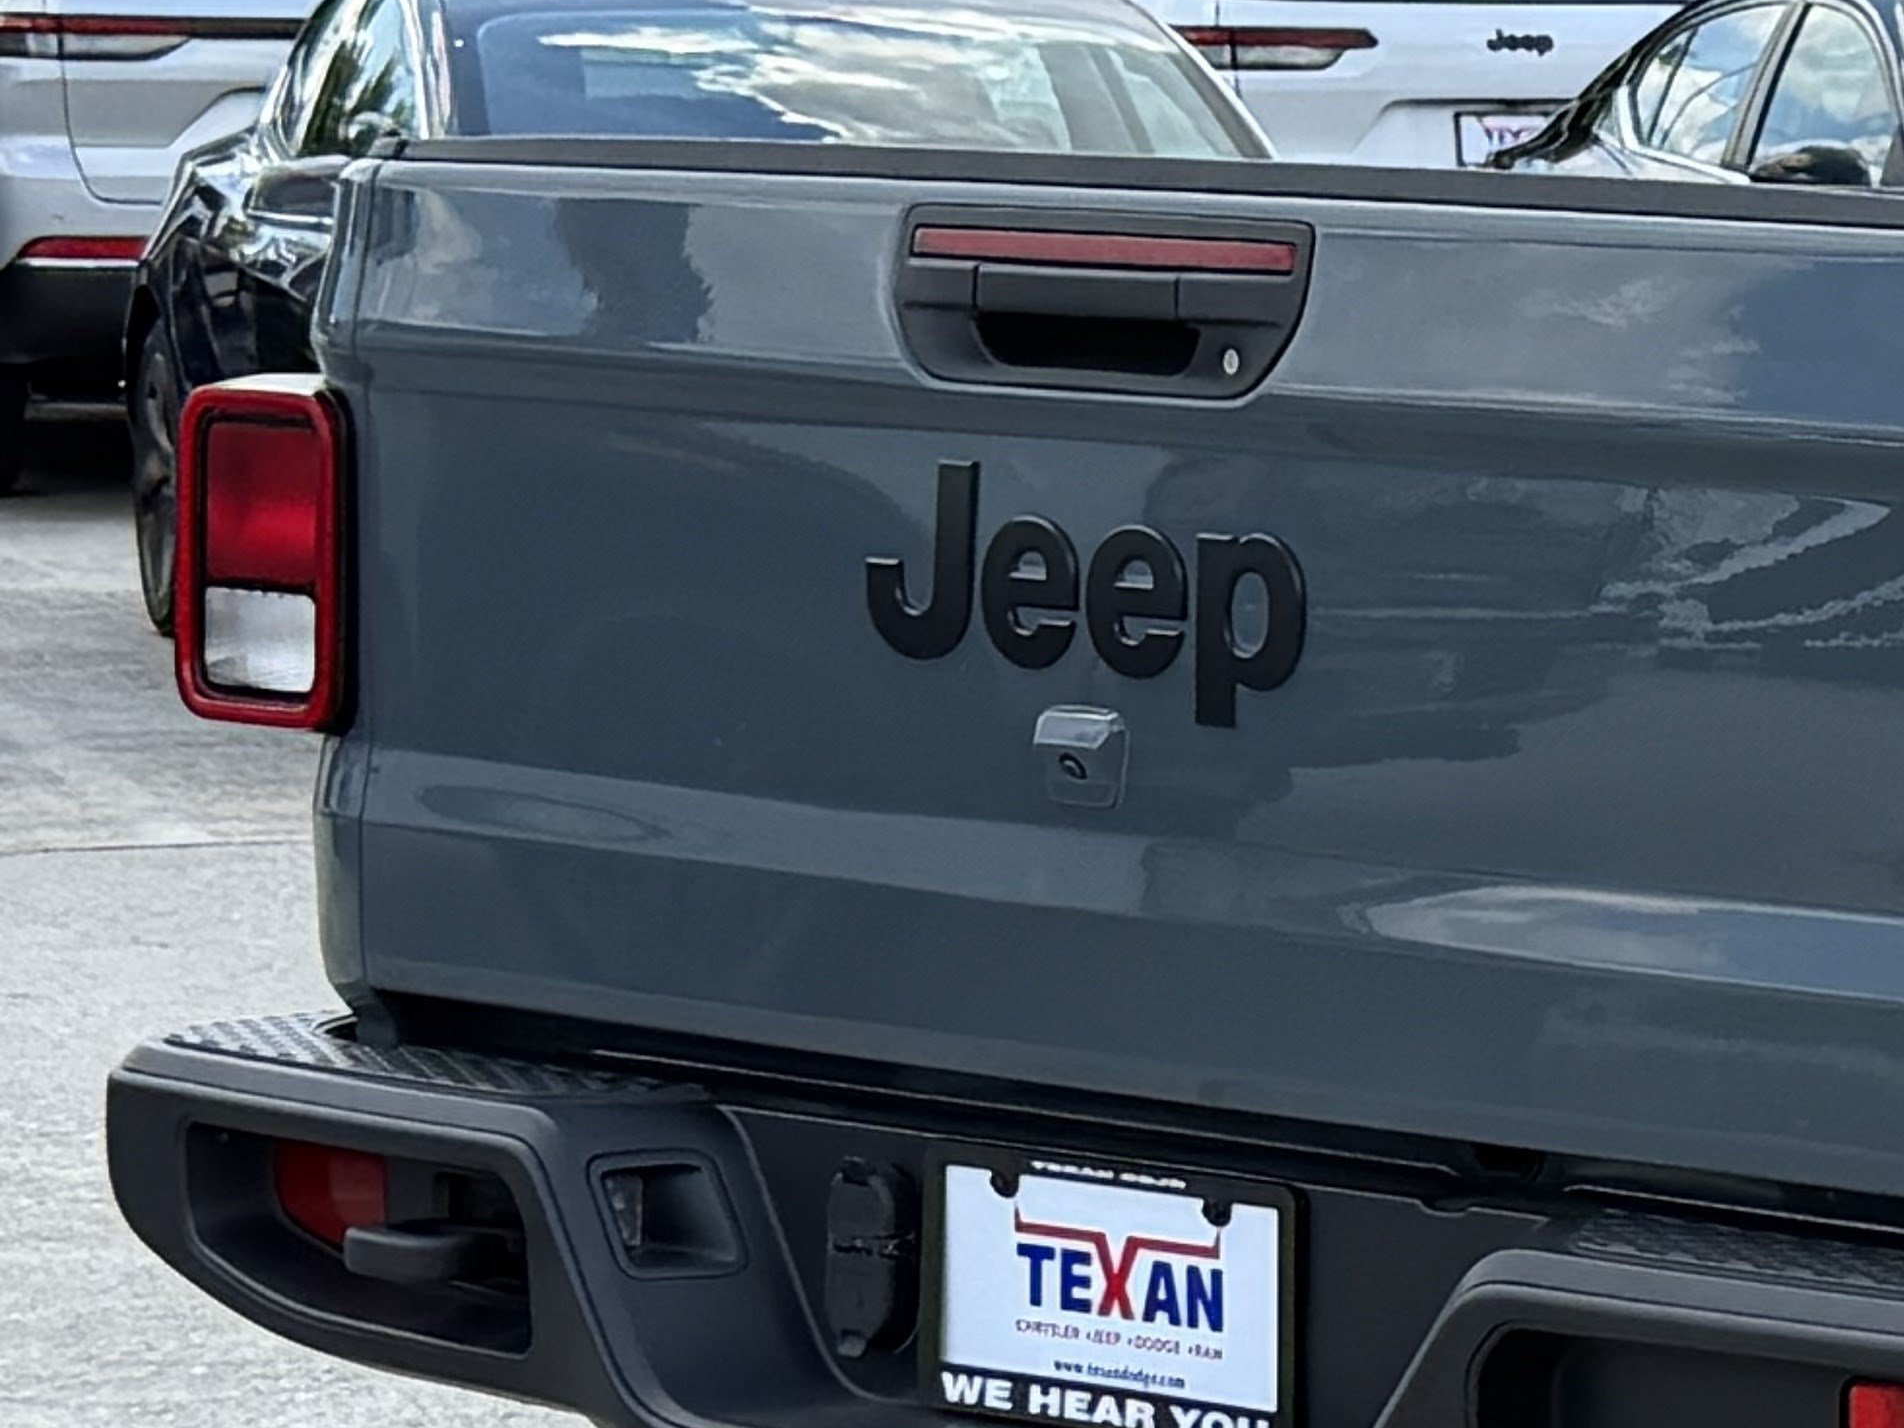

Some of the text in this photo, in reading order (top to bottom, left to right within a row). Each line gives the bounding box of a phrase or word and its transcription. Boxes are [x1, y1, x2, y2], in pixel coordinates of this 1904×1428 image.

[865, 459, 1308, 729] Jeep
[1014, 1217, 1224, 1333] TEXAN
[941, 1371, 1014, 1411] WE
